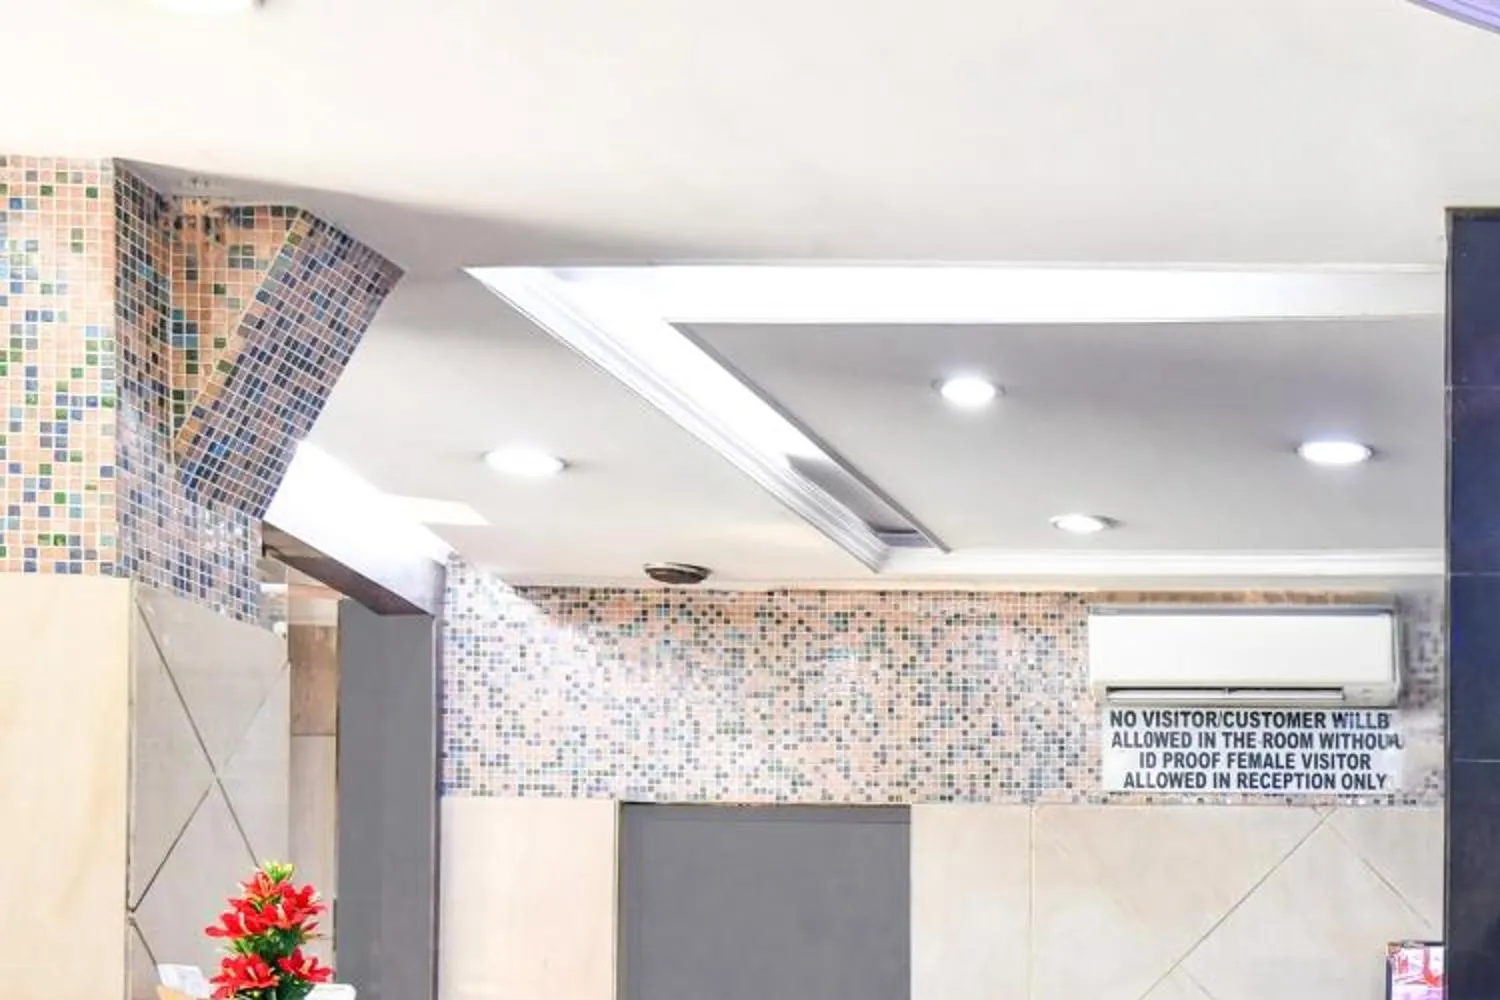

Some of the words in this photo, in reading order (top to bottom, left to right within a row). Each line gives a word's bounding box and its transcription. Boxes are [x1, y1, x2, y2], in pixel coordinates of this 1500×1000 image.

[1110, 710, 1137, 728] NO
[1111, 731, 1193, 749] ALLOWED
[1198, 731, 1216, 749] IN
[1221, 731, 1257, 749] THE
[1263, 731, 1314, 749] ROOM
[1139, 751, 1157, 769] ID
[1163, 751, 1221, 769] PROOF
[1226, 752, 1296, 769] FEMALE
[1301, 753, 1372, 770] VISITOR
[1123, 771, 1207, 789] ALLOWED
[1212, 772, 1231, 789] IN
[1236, 772, 1337, 789] RECEPTION
[1340, 773, 1388, 790] ONLY
